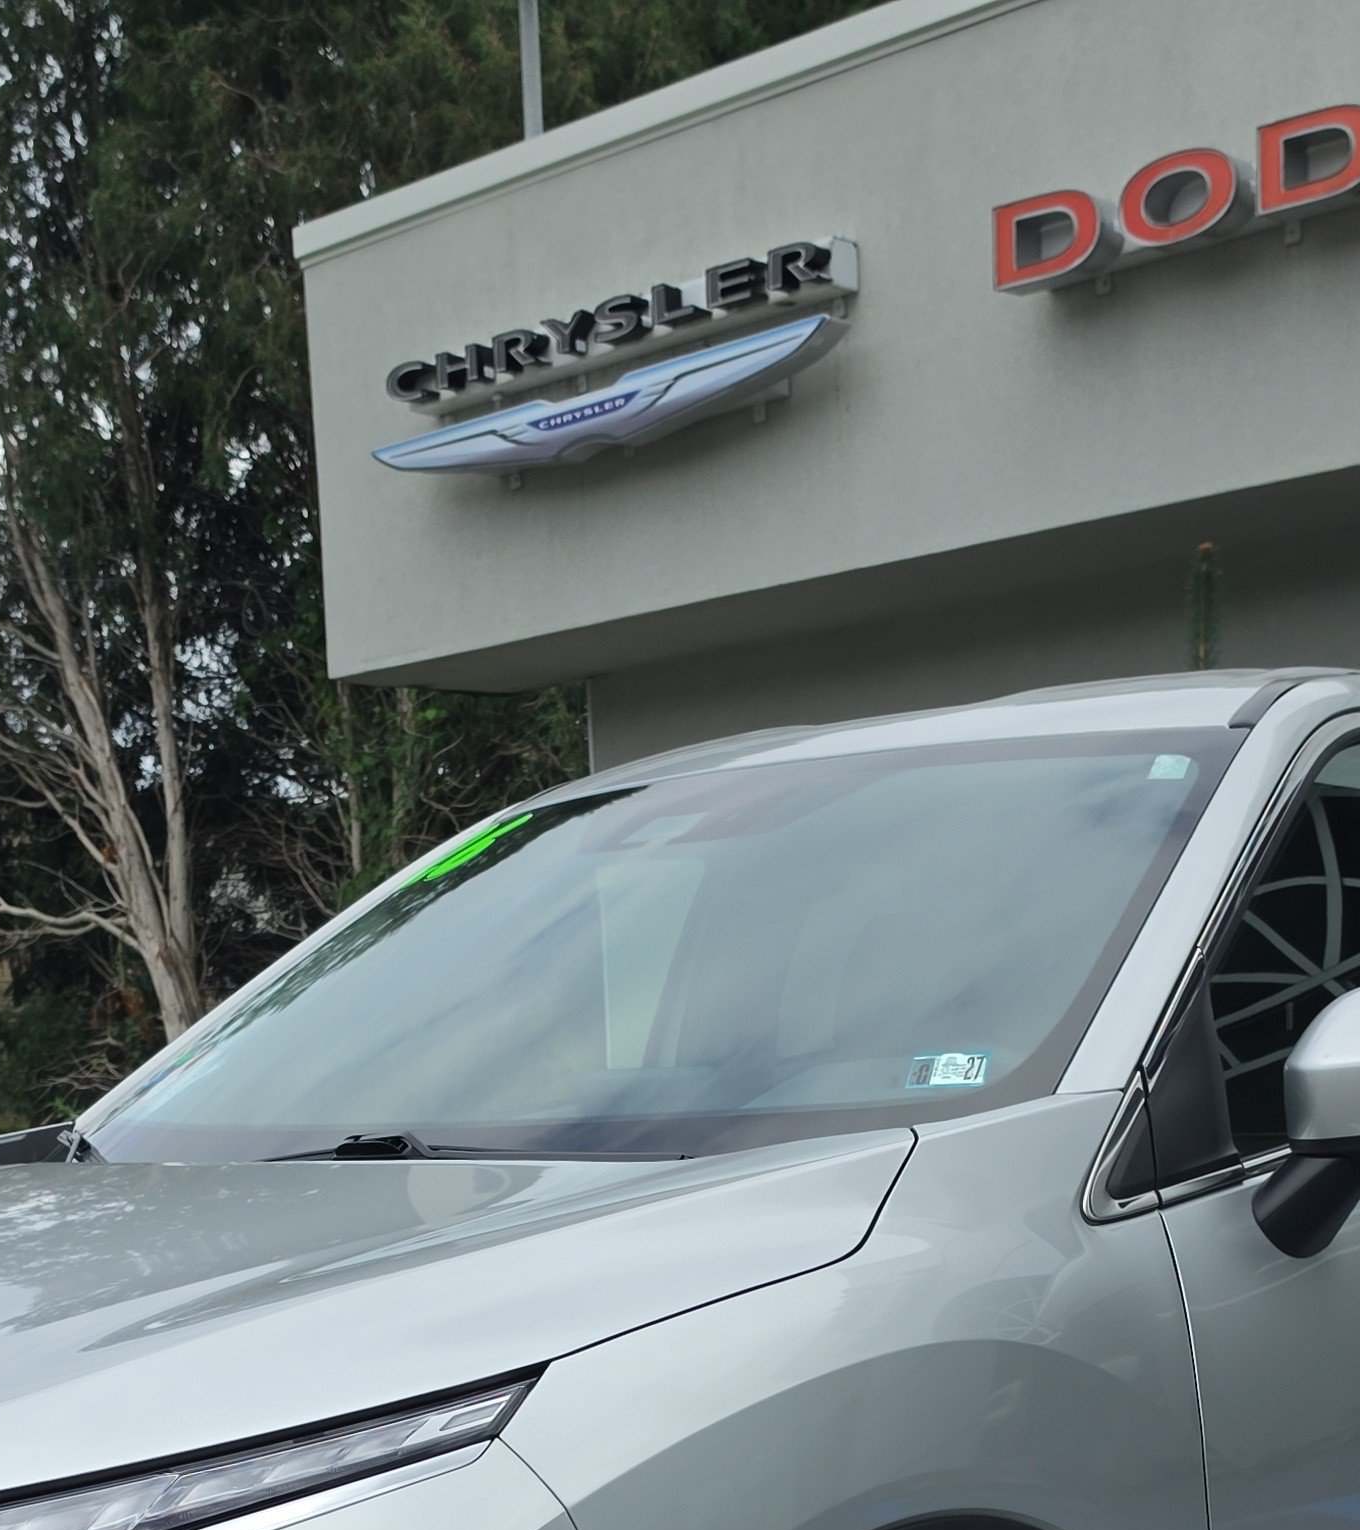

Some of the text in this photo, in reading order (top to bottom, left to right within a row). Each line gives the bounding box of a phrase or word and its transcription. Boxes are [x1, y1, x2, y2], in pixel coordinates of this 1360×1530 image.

[386, 240, 832, 404] CHRYSLER
[538, 398, 626, 430] CHRYSLER
[963, 1056, 986, 1081] 27
